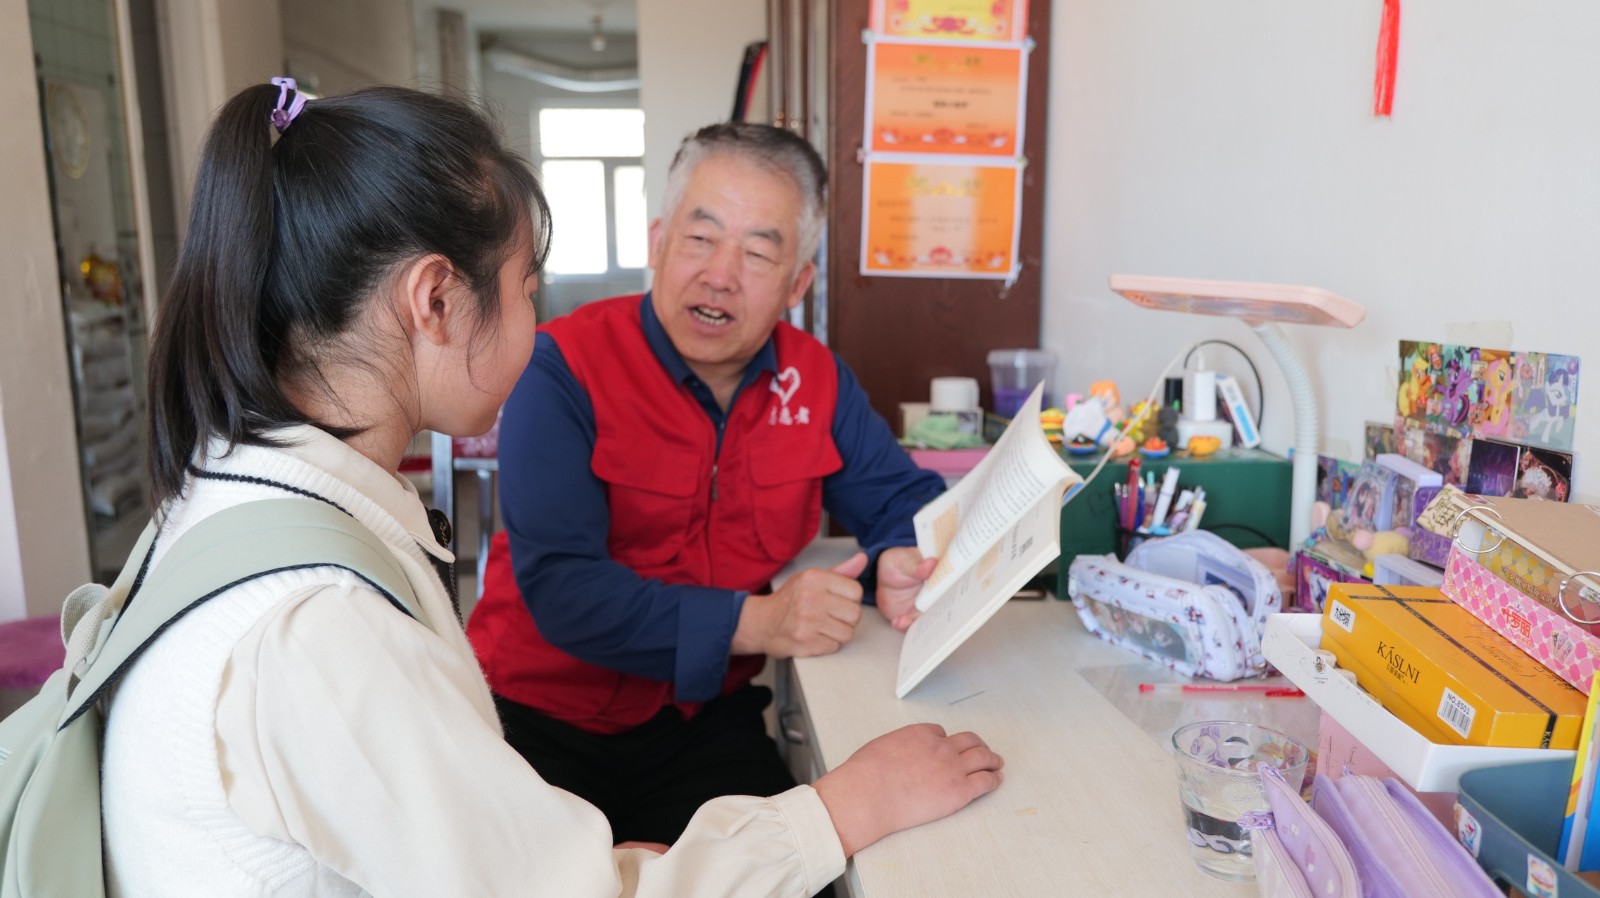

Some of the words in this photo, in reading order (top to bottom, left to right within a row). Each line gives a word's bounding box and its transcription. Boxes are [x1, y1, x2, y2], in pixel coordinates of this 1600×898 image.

[1501, 606, 1532, 638] 叶罗丽
[1447, 692, 1470, 716] NO.8501
